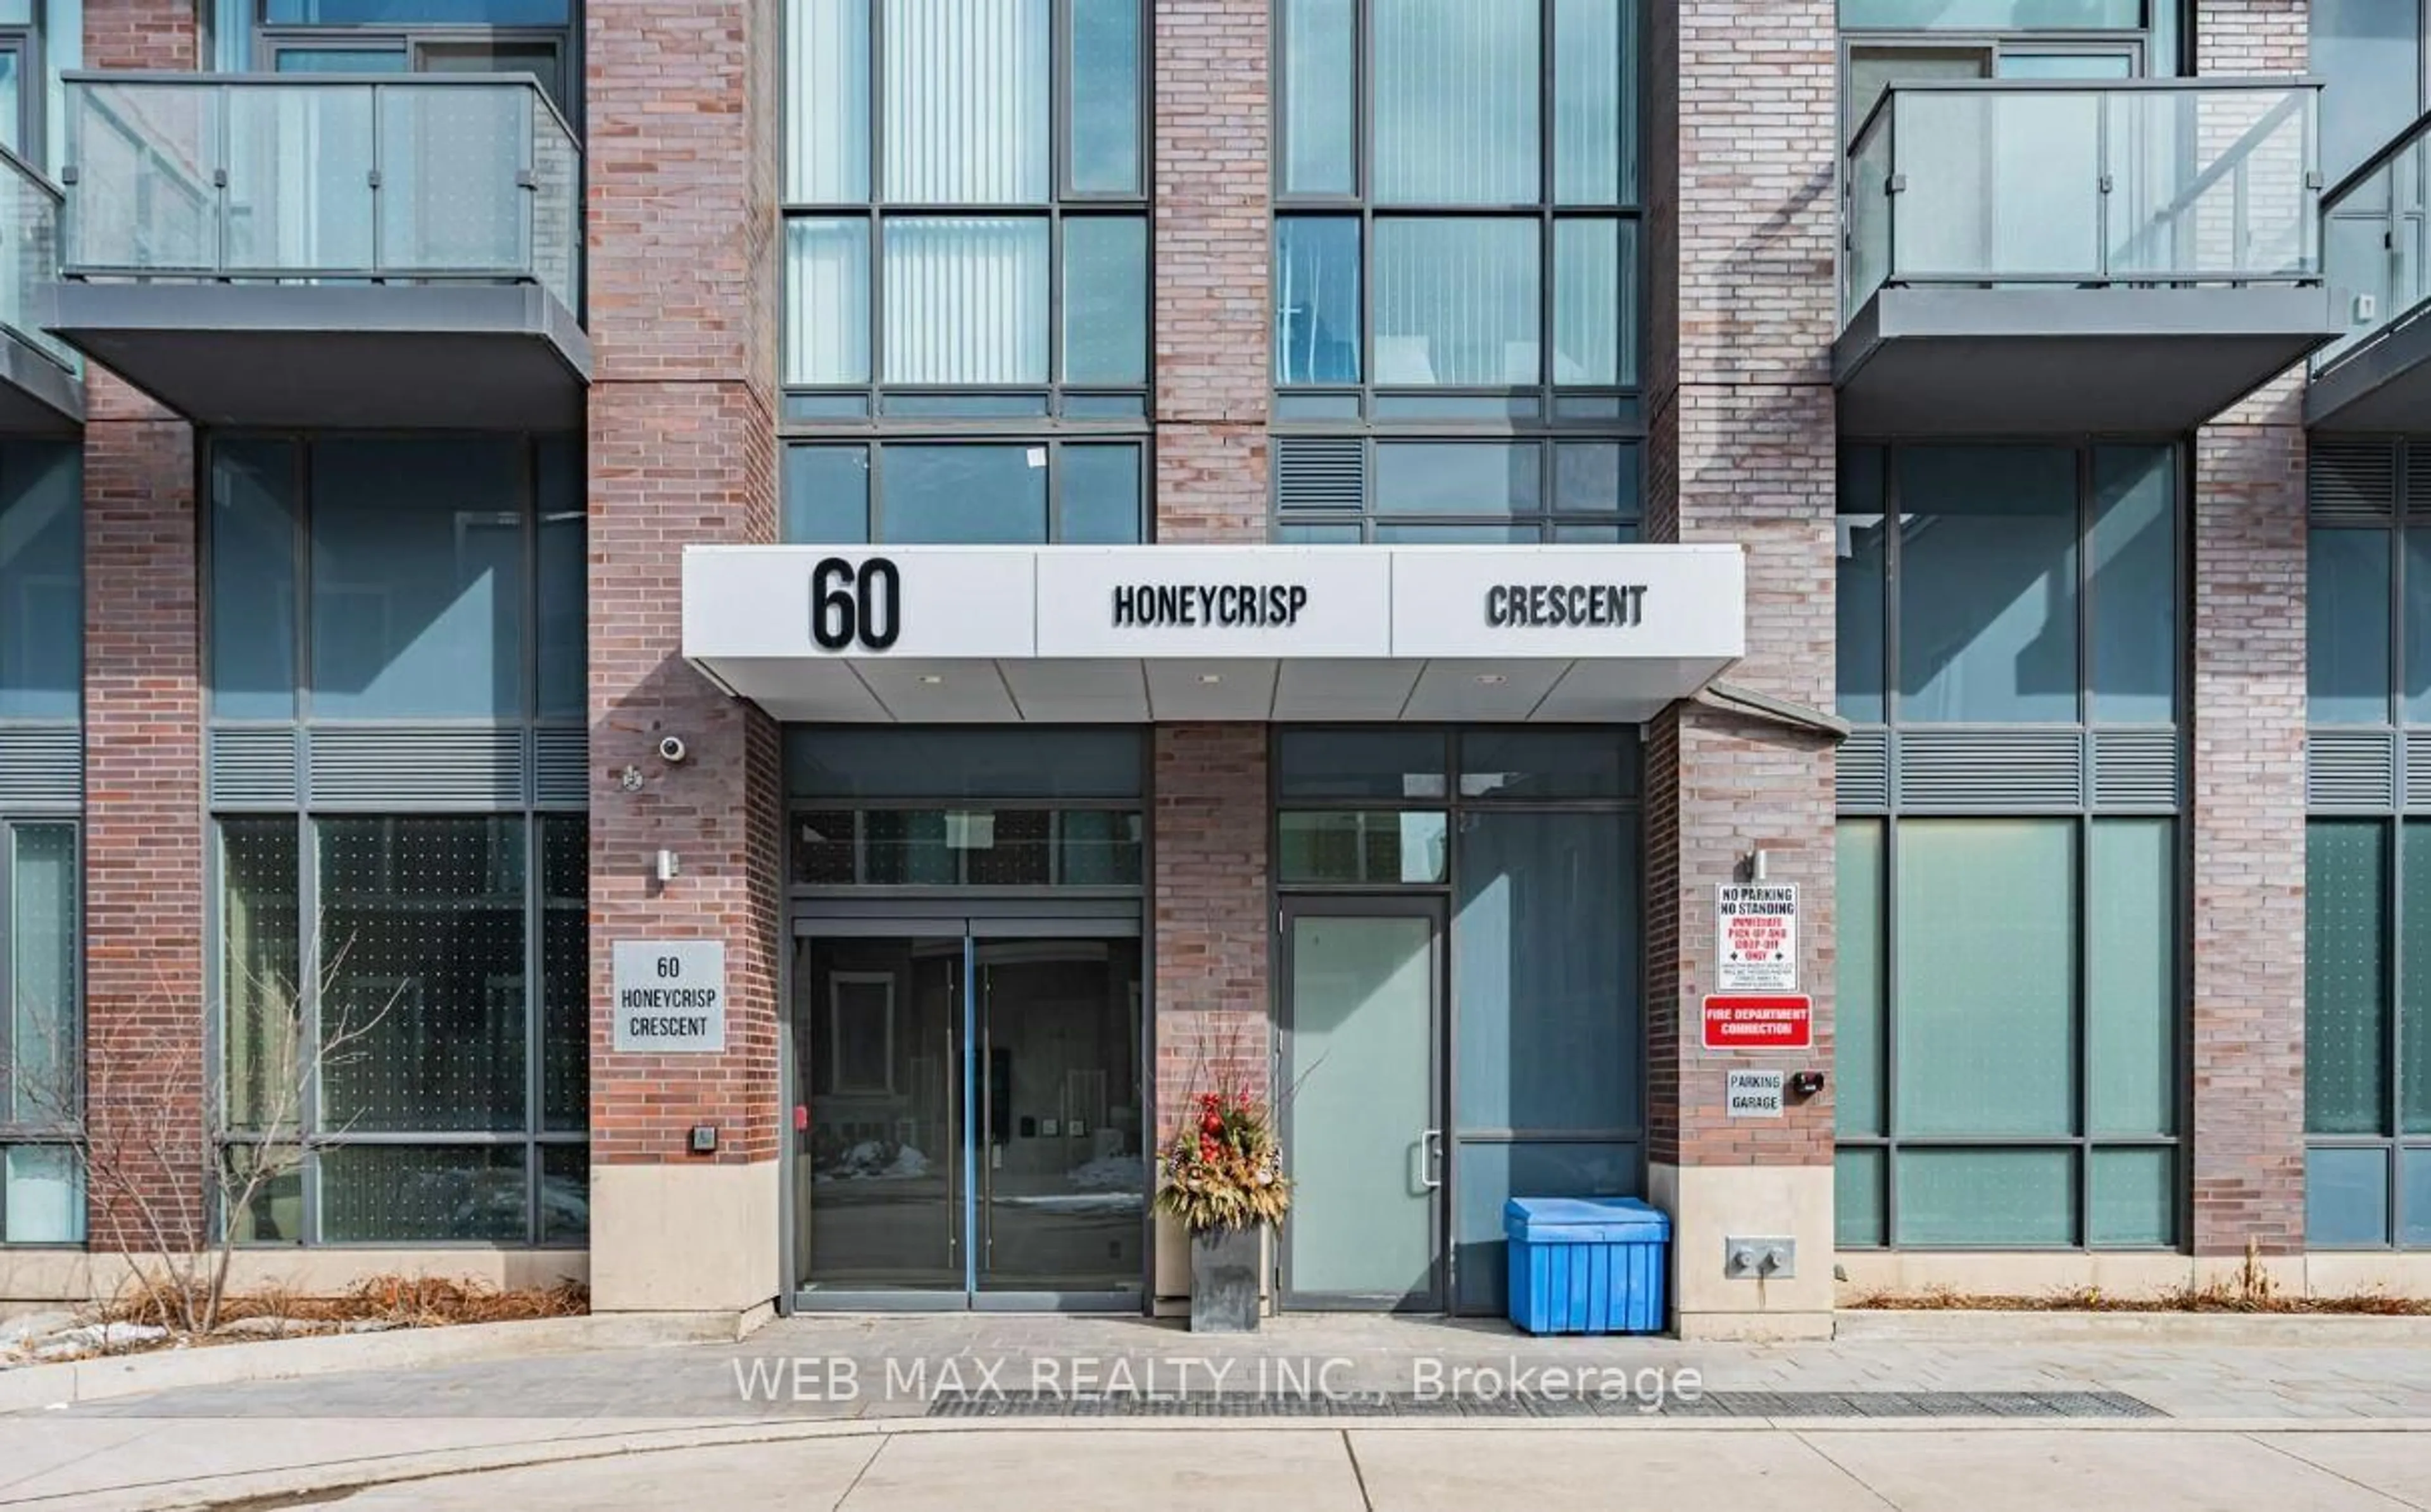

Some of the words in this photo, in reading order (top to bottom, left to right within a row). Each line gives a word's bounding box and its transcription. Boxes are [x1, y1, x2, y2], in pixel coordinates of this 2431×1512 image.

[812, 556, 900, 651] 60
[1114, 585, 1308, 626] HONEYCRISP
[1486, 584, 1648, 627] CRESCENT
[1723, 888, 1738, 901] NO
[1741, 888, 1792, 901] PARKING
[1721, 903, 1737, 915] NO
[1739, 903, 1795, 915] STANDING
[657, 956, 679, 978] 60
[621, 989, 716, 1008] HONEYCRISP
[1707, 1008, 1732, 1020] FIRE
[1735, 1008, 1807, 1020] DEPARTMENT
[629, 1016, 707, 1036] CRESCENT
[1721, 1023, 1792, 1035] CONNECTION
[1731, 1075, 1780, 1088] PARKING
[1733, 1096, 1778, 1109] GARAGE
